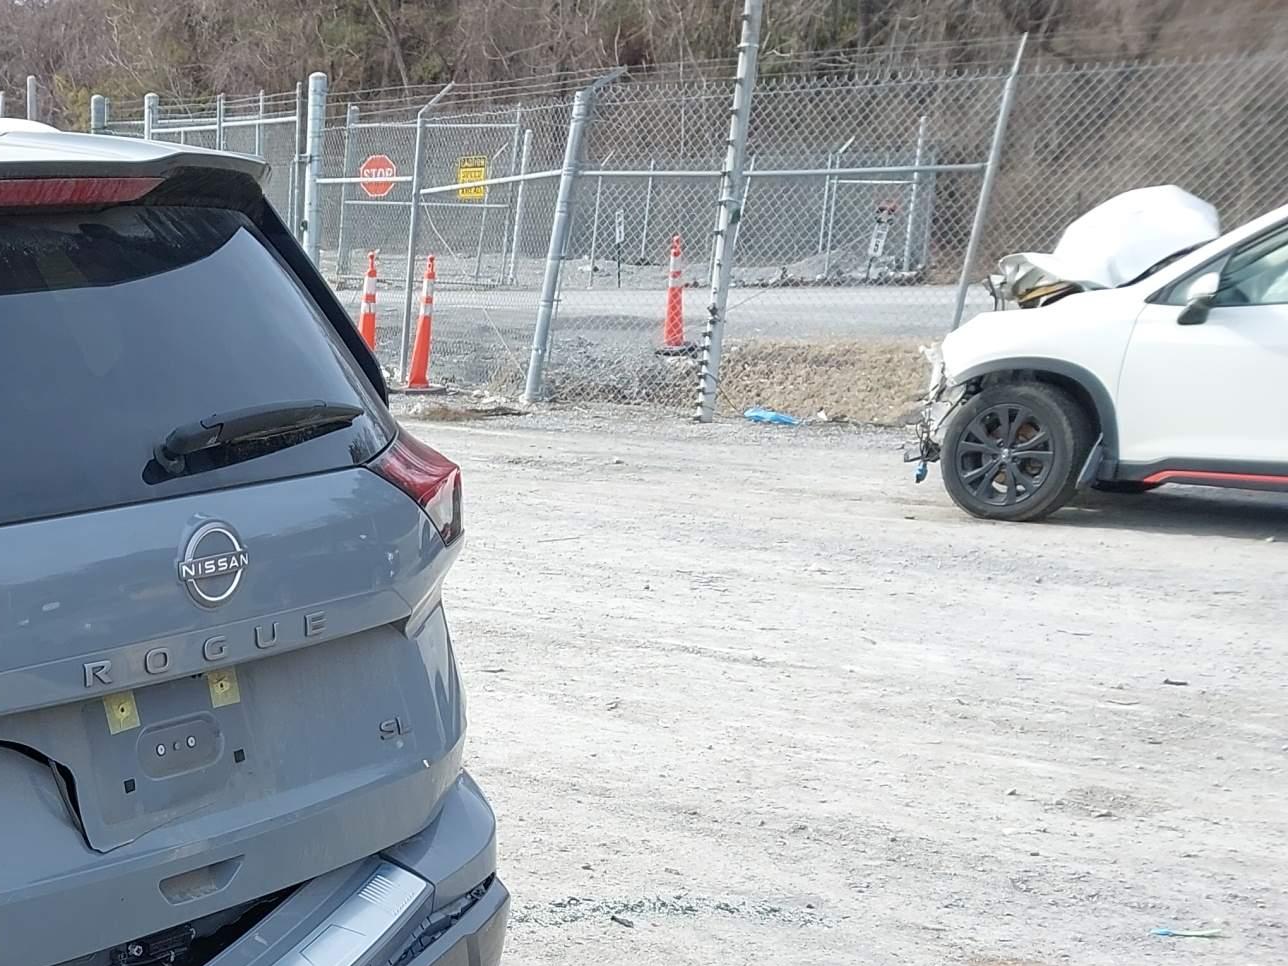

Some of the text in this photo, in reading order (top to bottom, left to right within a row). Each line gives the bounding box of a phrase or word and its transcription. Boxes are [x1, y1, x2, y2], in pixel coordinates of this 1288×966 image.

[364, 168, 393, 179] STOP
[182, 553, 248, 578] NISSAN
[83, 611, 327, 688] ROGUE
[379, 717, 412, 740] SL
